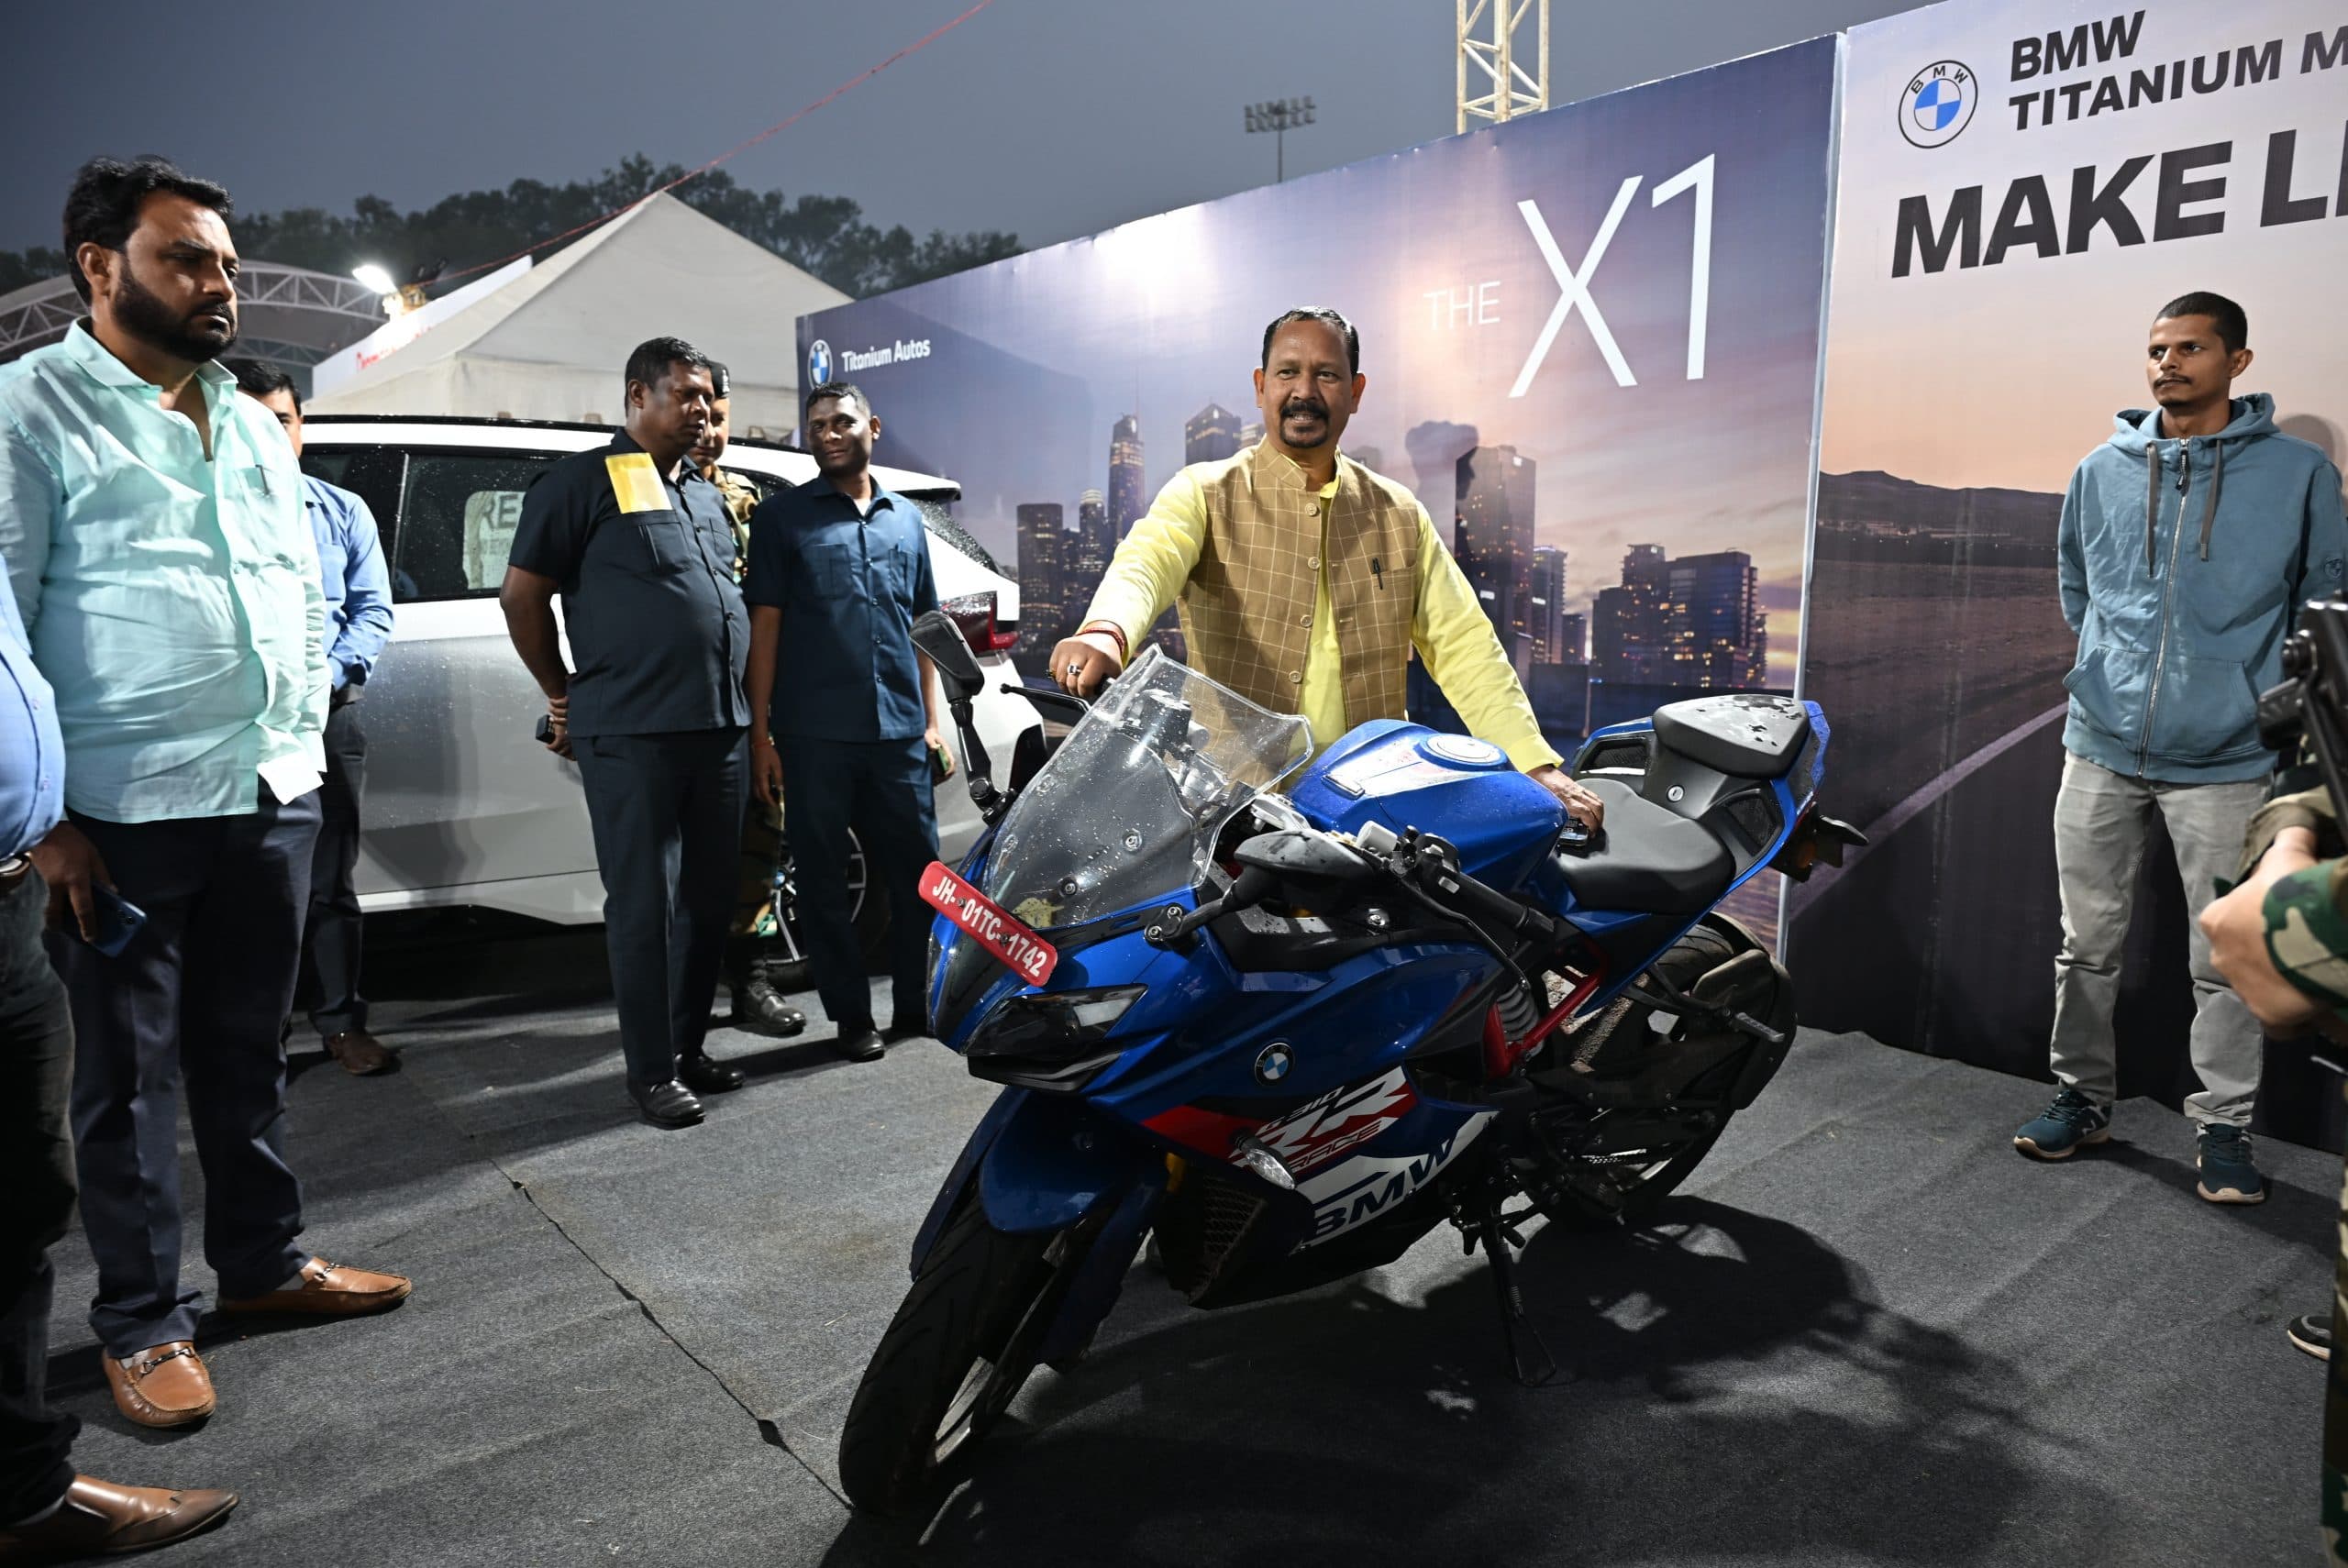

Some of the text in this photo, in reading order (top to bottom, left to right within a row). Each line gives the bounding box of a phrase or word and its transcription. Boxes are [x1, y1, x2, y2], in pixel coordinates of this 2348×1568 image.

[1911, 65, 1968, 94] BMW
[2008, 39, 2283, 130] TITANIUM
[2010, 10, 2145, 81] BMW
[1891, 140, 2232, 278] MAKE
[1423, 153, 1715, 398] THE X1
[840, 346, 892, 372] Titanium
[893, 339, 931, 362] Autos
[1314, 1135, 1456, 1237] BMW
